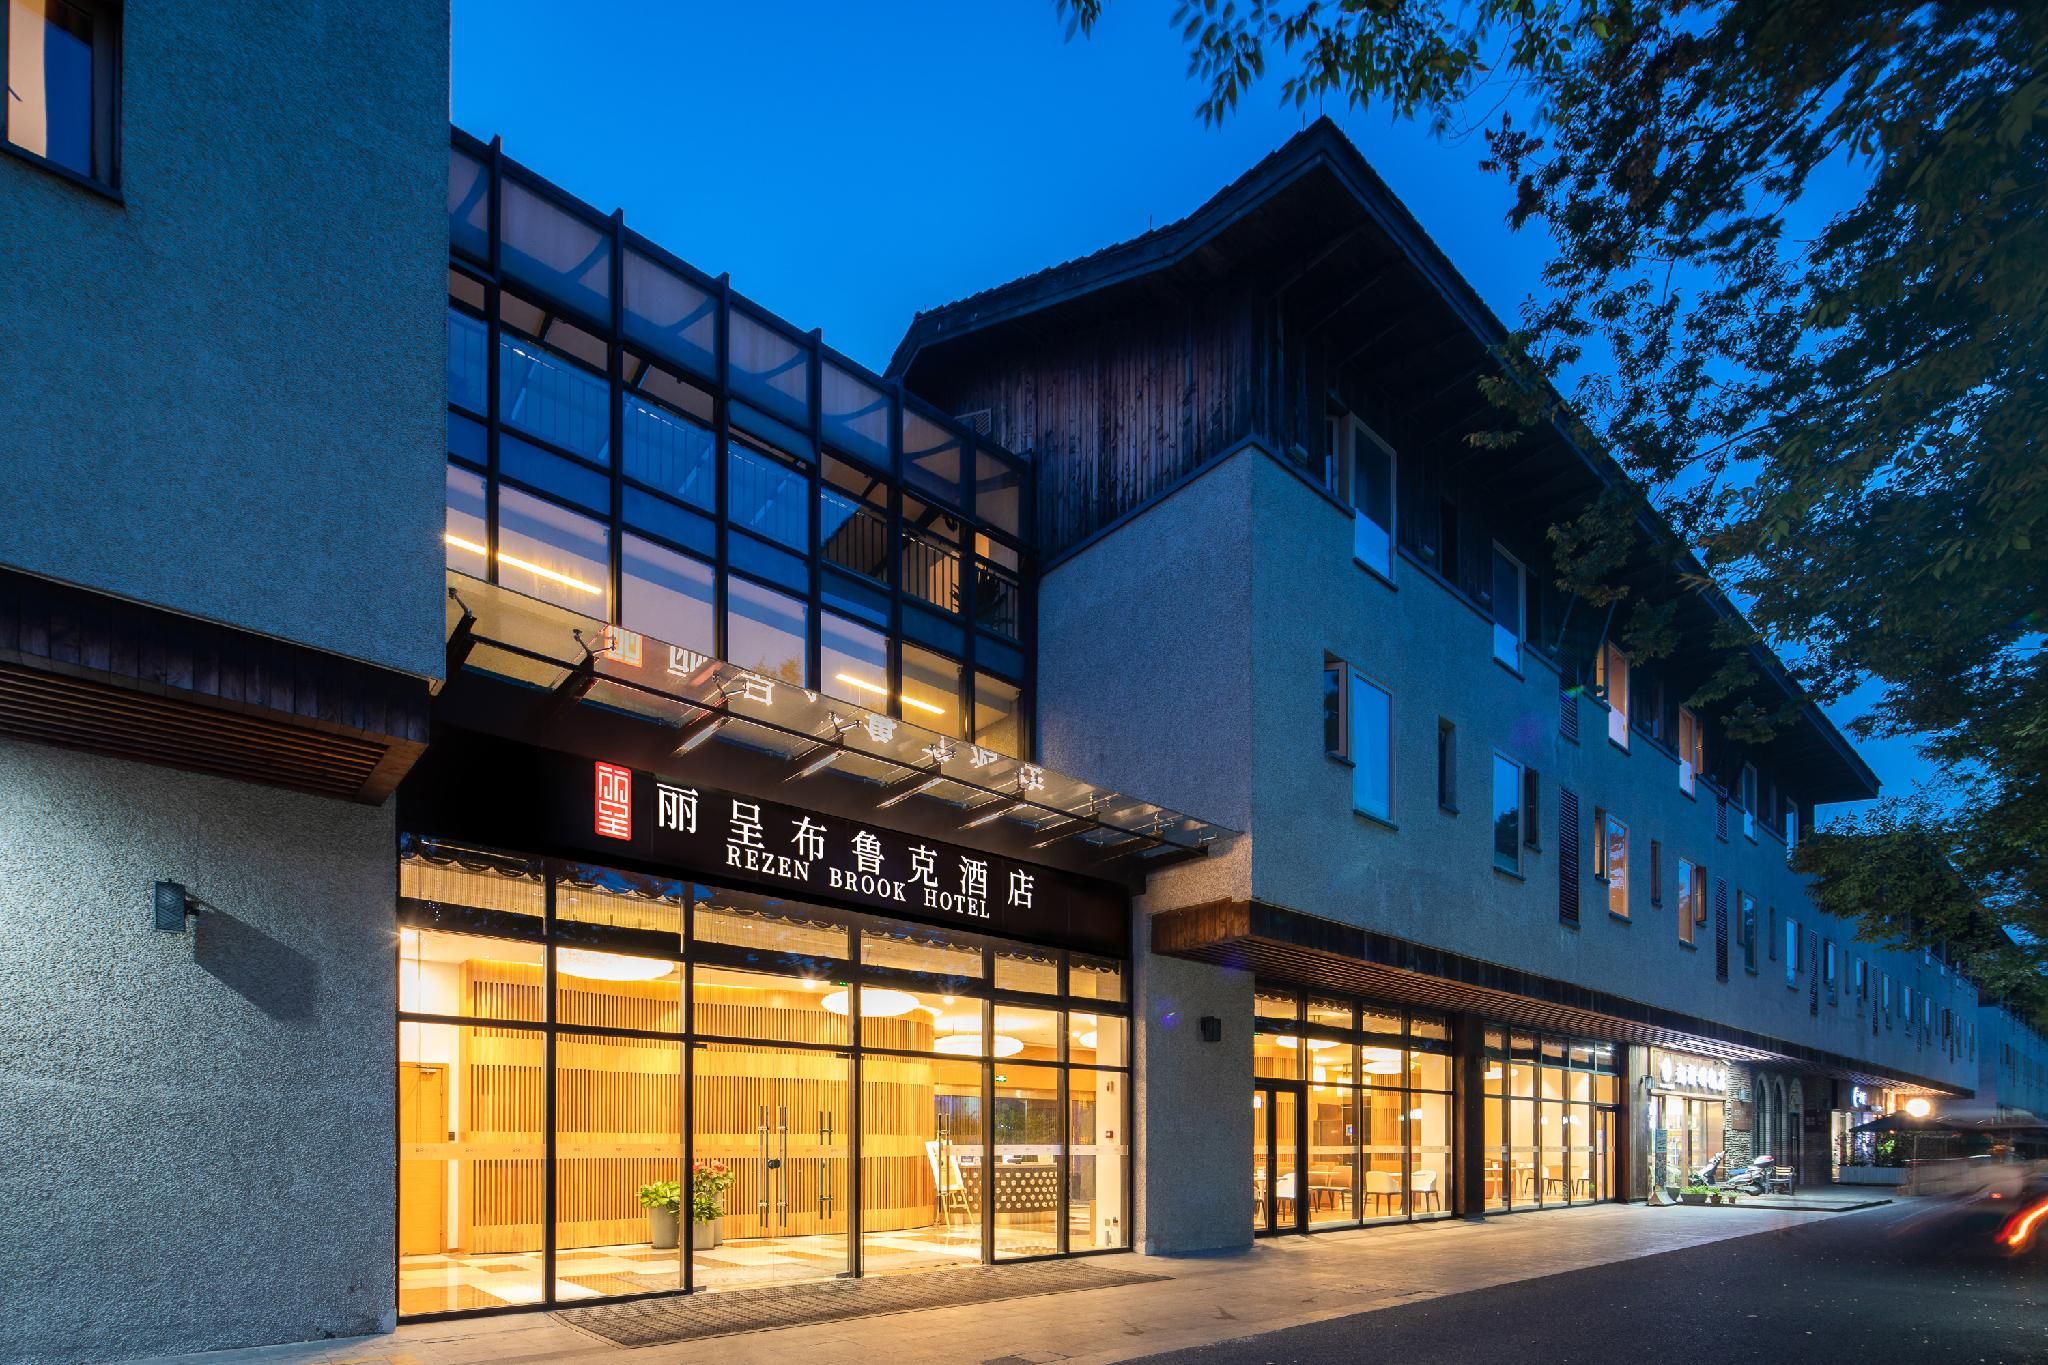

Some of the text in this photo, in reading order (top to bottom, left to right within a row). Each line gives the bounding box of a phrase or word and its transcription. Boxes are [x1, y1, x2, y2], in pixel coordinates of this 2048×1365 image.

[656, 783, 1035, 909] 丽呈布鲁克酒店
[725, 844, 990, 919] REZEN BROOK HOTEL
